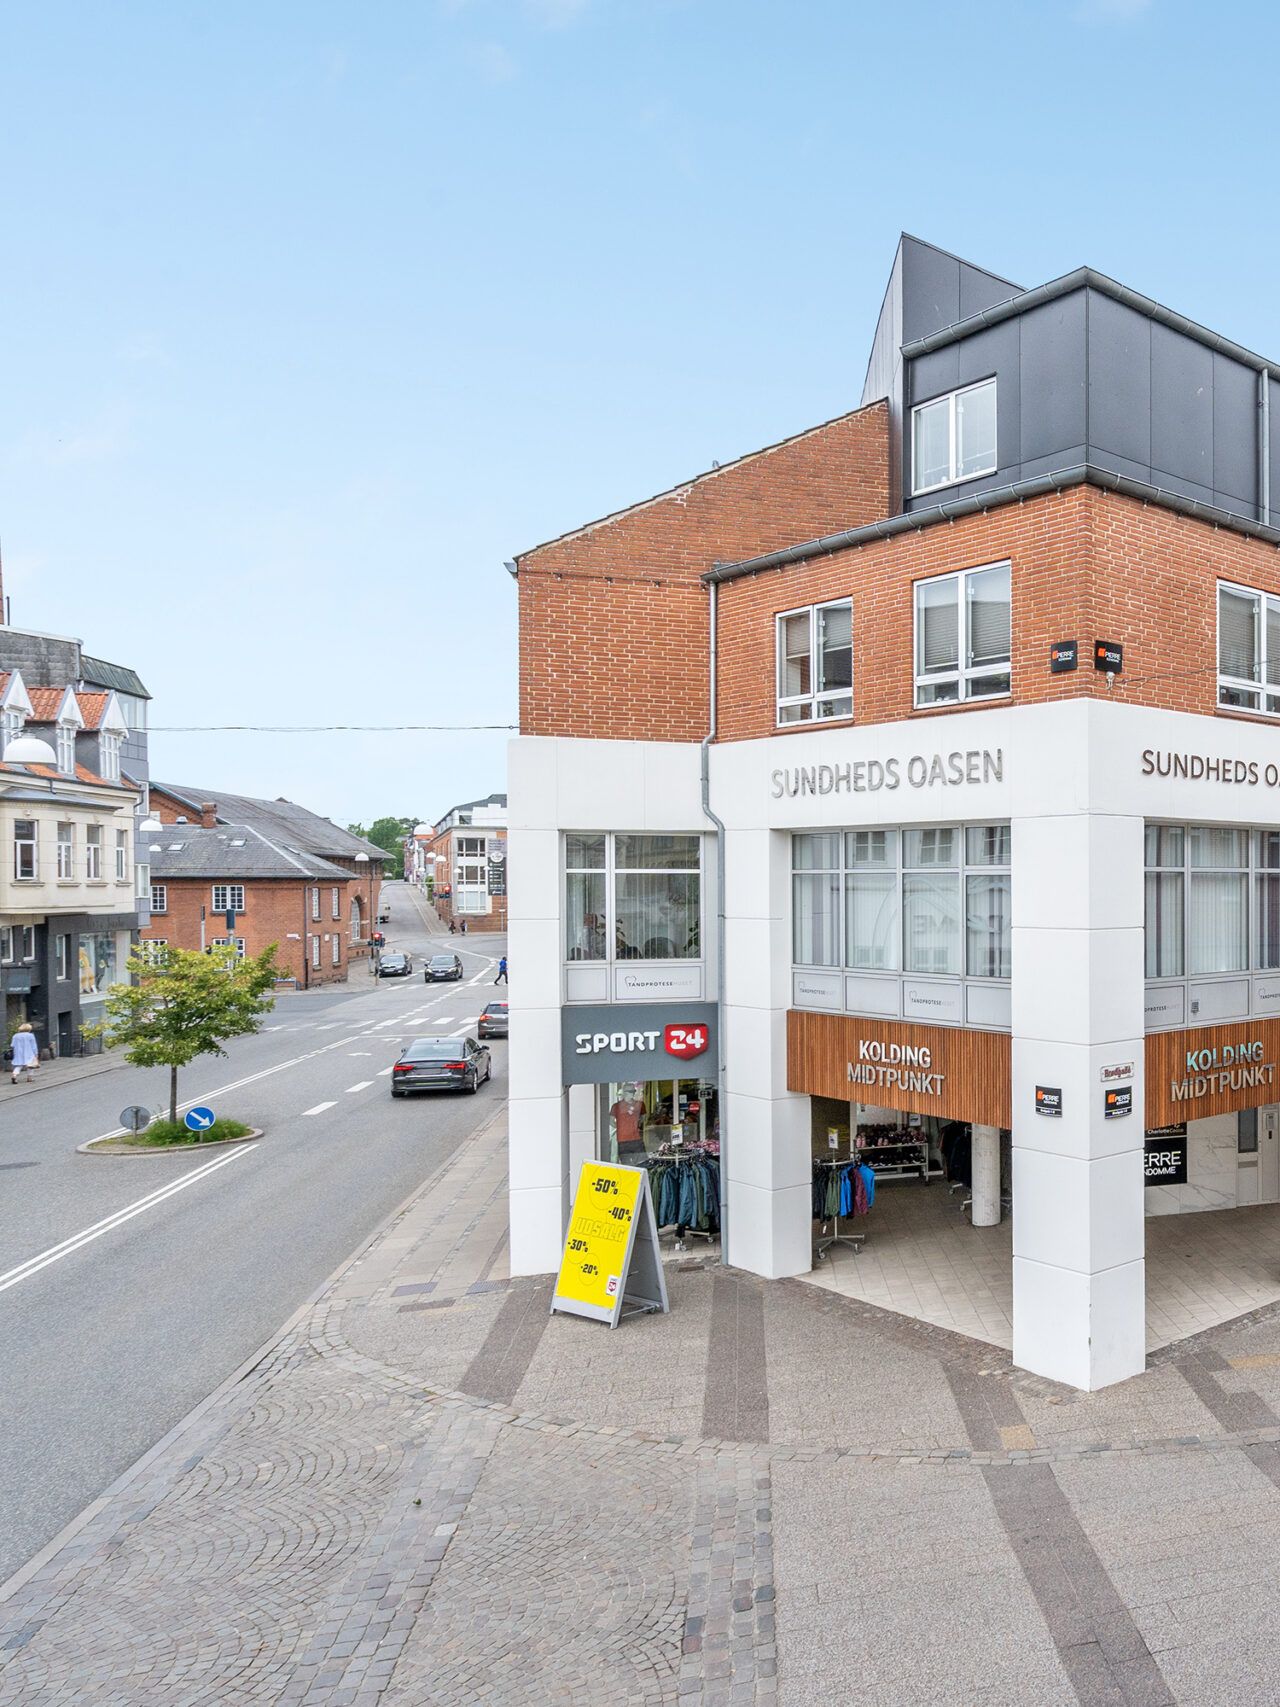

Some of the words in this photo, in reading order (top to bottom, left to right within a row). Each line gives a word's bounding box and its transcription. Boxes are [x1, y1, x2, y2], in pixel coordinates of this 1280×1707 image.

[771, 758, 900, 798] SUNDHEDS
[907, 748, 1003, 788] OASEN
[1142, 749, 1259, 785] SUNDHEDS
[575, 1031, 661, 1054] SPORT
[670, 1029, 705, 1050] 24
[859, 1040, 931, 1069] KOLDING
[1186, 1041, 1264, 1073] KOLDING
[848, 1062, 945, 1096] MIDTPUNKT
[1171, 1063, 1277, 1102] MIDTPUNKT
[591, 1178, 618, 1195] -50%
[608, 1206, 632, 1222] -40%
[574, 1217, 627, 1243] UDSALG
[567, 1239, 589, 1253] -30%
[580, 1264, 599, 1276] -20%
